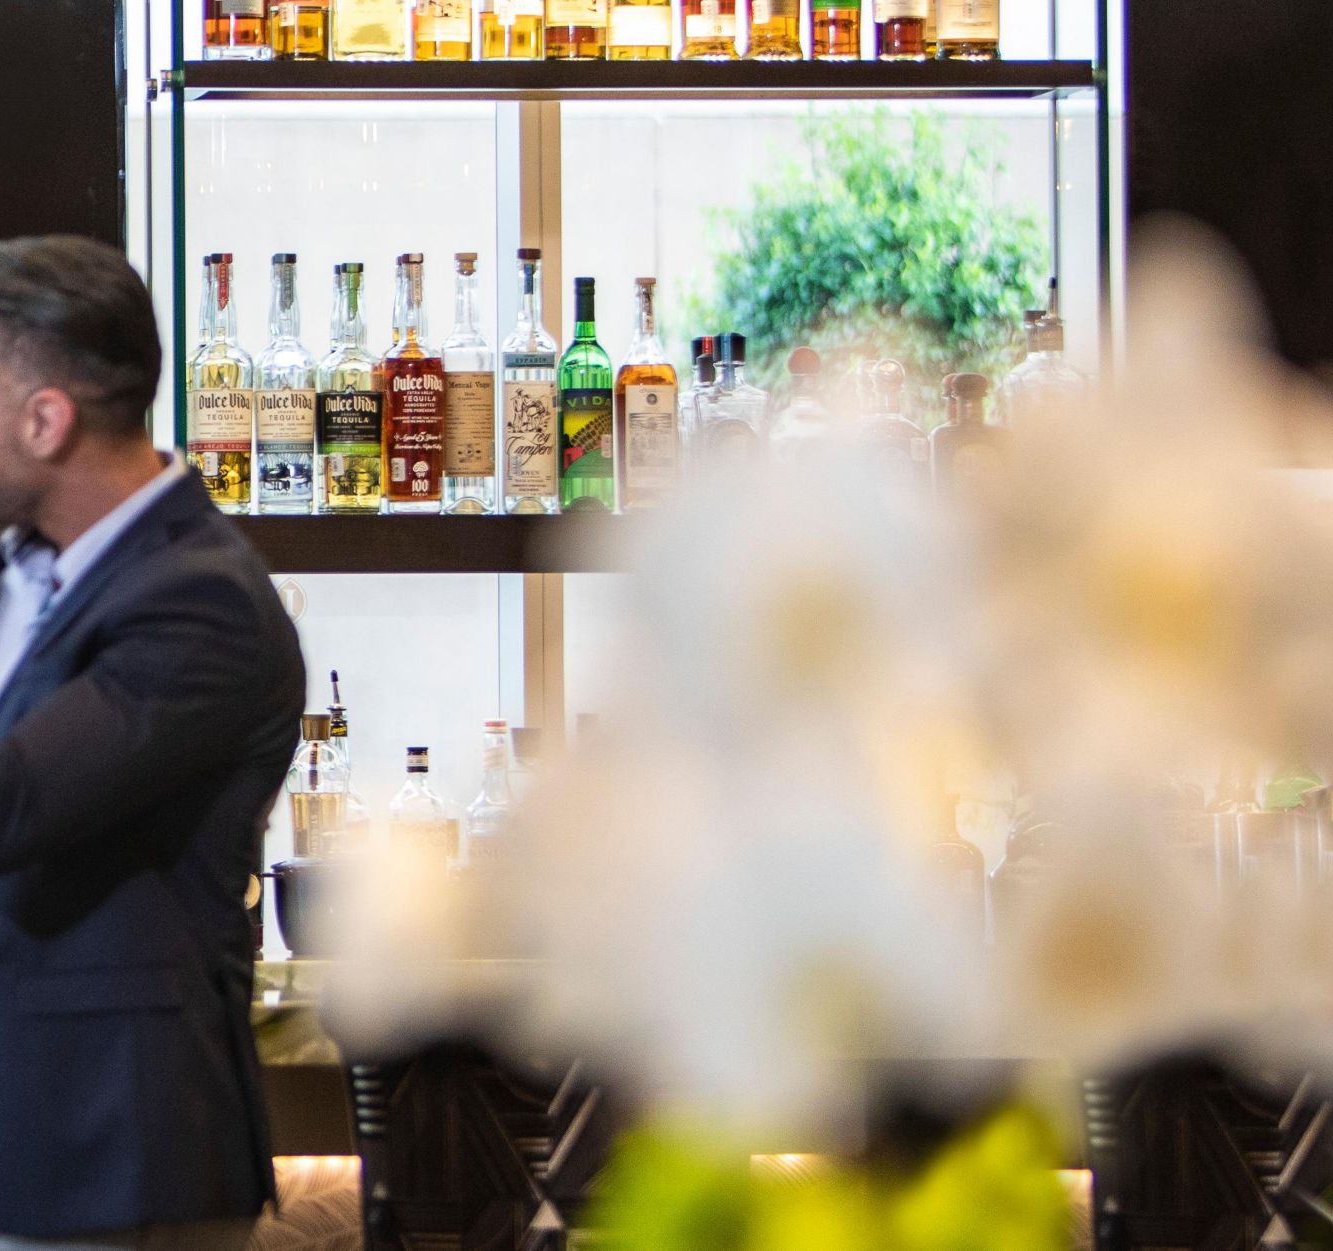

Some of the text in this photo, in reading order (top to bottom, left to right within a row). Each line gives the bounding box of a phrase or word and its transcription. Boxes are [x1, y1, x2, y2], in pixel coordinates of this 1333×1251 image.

[393, 374, 444, 392] Dulce Vida
[198, 393, 251, 410] Dulce Vida
[260, 393, 313, 411] Dulce Vida
[325, 395, 378, 413] Dulce Vida
[412, 479, 429, 492] 100
